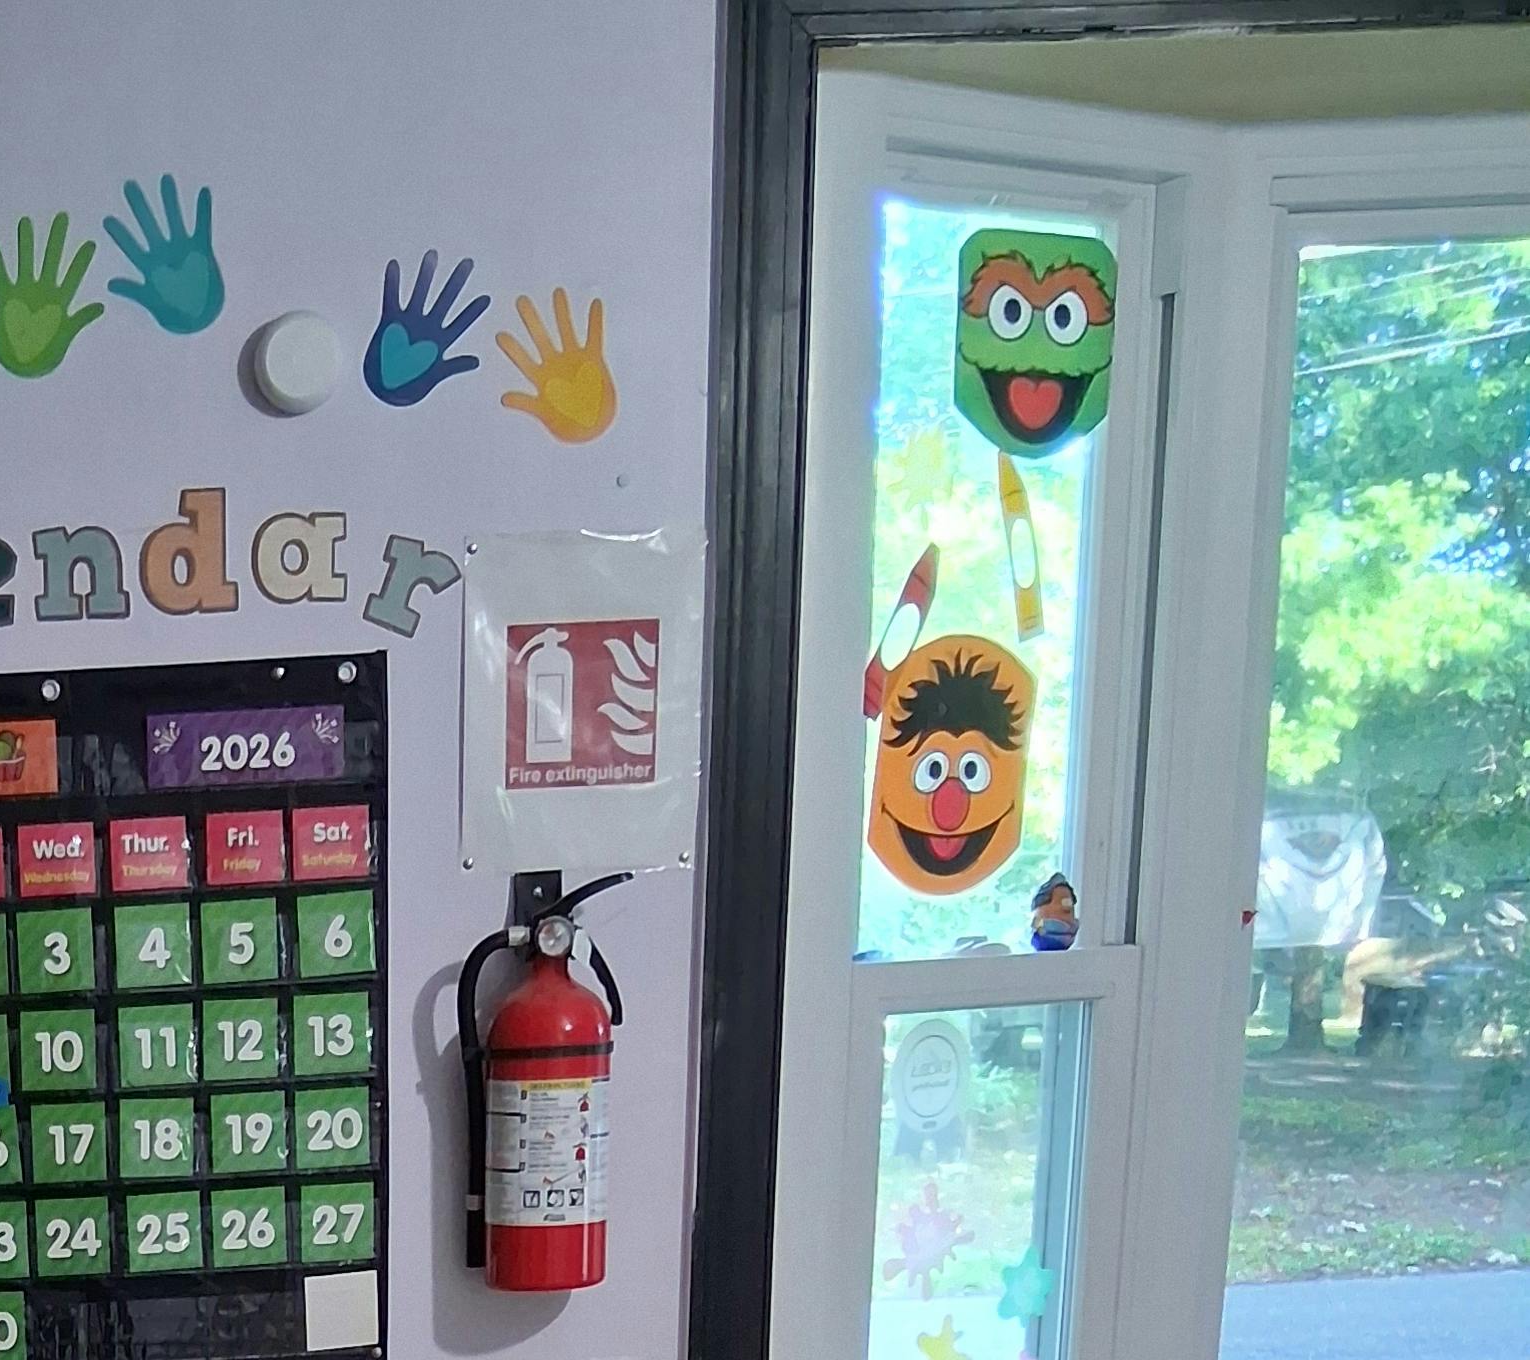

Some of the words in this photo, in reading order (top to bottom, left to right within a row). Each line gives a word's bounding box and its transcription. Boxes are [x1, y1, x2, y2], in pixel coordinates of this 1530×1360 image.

[199, 732, 297, 774] 2026
[509, 766, 541, 784] Fire
[545, 762, 653, 785] extinguisher
[33, 838, 85, 860] Wed.
[120, 834, 170, 854] Thur.
[227, 826, 260, 848] Fri.
[313, 821, 353, 843] Sat.
[23, 868, 90, 886] Wednesday
[122, 862, 178, 878] Thursday
[223, 857, 262, 873] Friday
[302, 852, 357, 868] Saturday
[44, 932, 71, 975] 3
[138, 928, 170, 968] 4
[228, 922, 255, 965] 5
[324, 915, 352, 958] 6
[34, 1031, 84, 1072] 10
[134, 1026, 177, 1069] 11
[217, 1020, 264, 1062] 12
[307, 1014, 354, 1057] 13
[48, 1124, 95, 1165] 17
[134, 1118, 182, 1161] 18
[225, 1112, 273, 1155] 19
[306, 1107, 363, 1150] 20
[46, 1217, 101, 1259] 24
[136, 1212, 190, 1255] 25
[221, 1206, 276, 1250] 26
[312, 1202, 365, 1246] 27
